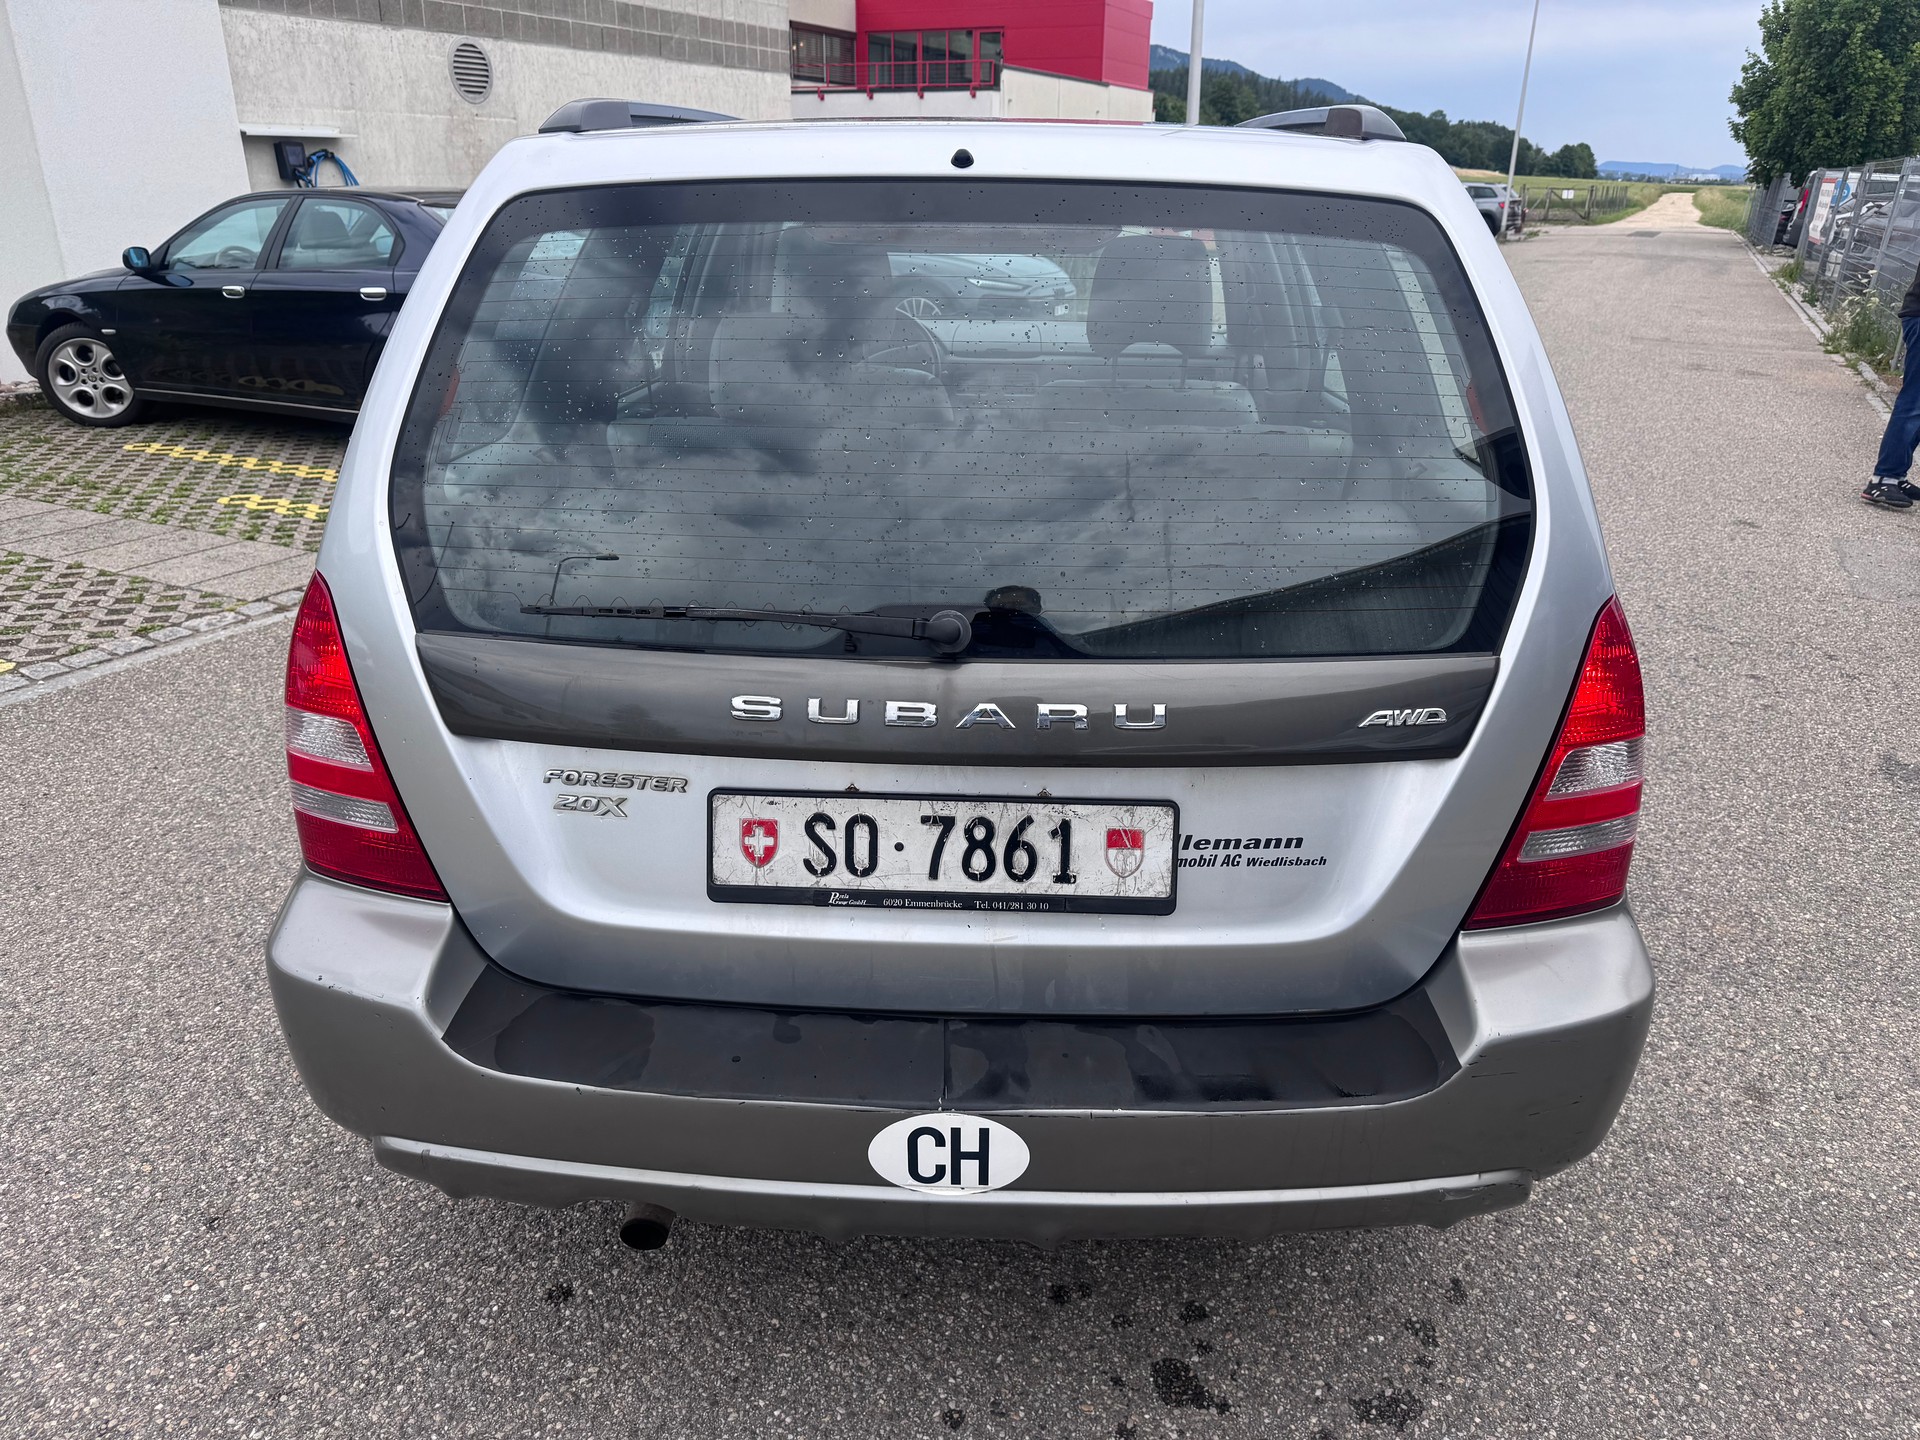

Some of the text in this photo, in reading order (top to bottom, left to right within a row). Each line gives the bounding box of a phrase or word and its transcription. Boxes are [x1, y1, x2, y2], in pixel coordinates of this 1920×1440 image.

[730, 694, 1168, 731] SUBARU
[1357, 707, 1448, 729] AWD
[543, 768, 689, 794] FORESTER
[1177, 833, 1304, 851] lemann
[1220, 853, 1243, 868] AG
[1245, 855, 1328, 868] Wiedlisbach
[882, 897, 904, 908] 6020
[904, 898, 964, 909] Emmenbrücke
[973, 900, 991, 910] Tel.
[1026, 901, 1038, 911] 30
[1039, 901, 1050, 911] 10
[907, 1126, 990, 1186] CH
